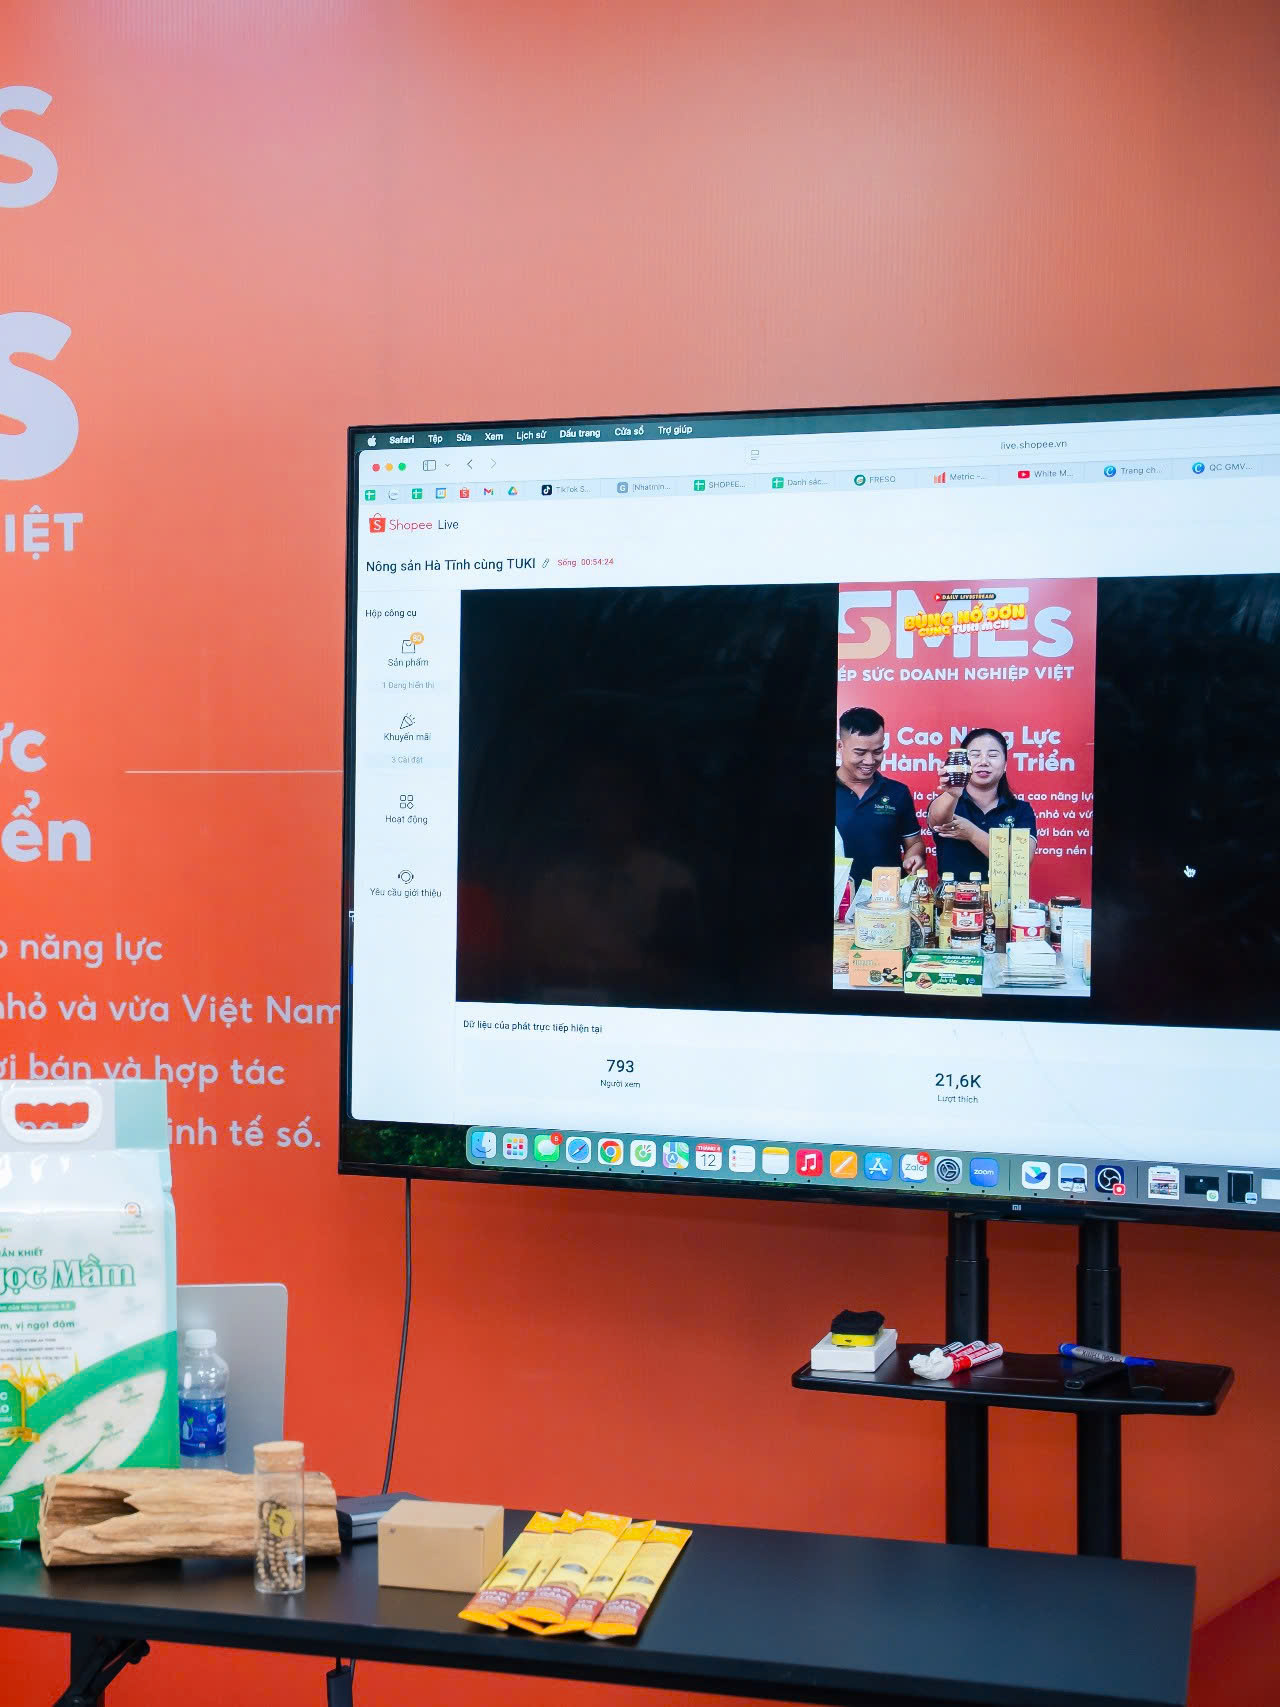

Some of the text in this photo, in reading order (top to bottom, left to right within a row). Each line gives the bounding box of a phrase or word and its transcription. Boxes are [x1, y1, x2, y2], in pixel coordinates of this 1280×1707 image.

[390, 435, 415, 444] Safari
[428, 434, 443, 444] Tệp
[457, 433, 472, 442] Sửa
[485, 432, 504, 441] Xem
[516, 431, 533, 442] Lịch
[560, 428, 577, 439] Dấu
[578, 429, 601, 440] trang
[658, 425, 672, 436] Trợ
[673, 425, 693, 436] giúp
[1000, 440, 1068, 452] live.shopee.vn
[1034, 469, 1057, 478] White
[389, 519, 459, 532] Shopee Live
[366, 559, 397, 574] Nông
[425, 559, 441, 571] Hà
[474, 558, 503, 573] cùng
[507, 557, 536, 570] TUKI
[581, 557, 614, 566] 00:54:24
[365, 609, 382, 620] Hộp
[384, 609, 402, 620] công
[387, 657, 404, 668] Sản
[863, 664, 1075, 682] SỨC DOANH NGHIỆP VIỆT
[383, 731, 414, 743] Khuyến
[897, 726, 943, 745] Cao
[1022, 726, 1061, 749] Lực
[1013, 748, 1075, 772] Triển
[385, 815, 405, 825] Hoạt
[370, 886, 442, 899] Yêu cầu giới thiệu
[20, 934, 103, 968] năng
[116, 933, 163, 965] lực
[58, 994, 96, 1020] và
[109, 995, 169, 1022] vừa
[182, 994, 253, 1028] Việt
[267, 996, 340, 1024] Nam
[477, 1020, 492, 1031] liệu
[494, 1021, 510, 1030] của
[512, 1021, 531, 1032] phát
[533, 1022, 551, 1033] trực
[552, 1022, 569, 1034] tiếp
[571, 1023, 589, 1034] hiện
[591, 1024, 603, 1035] tại
[29, 1053, 91, 1080] bán
[103, 1056, 141, 1080] và
[155, 1055, 218, 1092] hợp
[230, 1058, 285, 1086] tác
[606, 1059, 635, 1073] 793
[624, 1081, 641, 1089] xem
[935, 1072, 982, 1089] 21,6K
[230, 1115, 321, 1148] tế số.
[700, 1154, 716, 1167] 12
[905, 1163, 925, 1172] Zalo
[974, 1168, 995, 1176] zoom
[50, 1253, 137, 1290] Mầm
